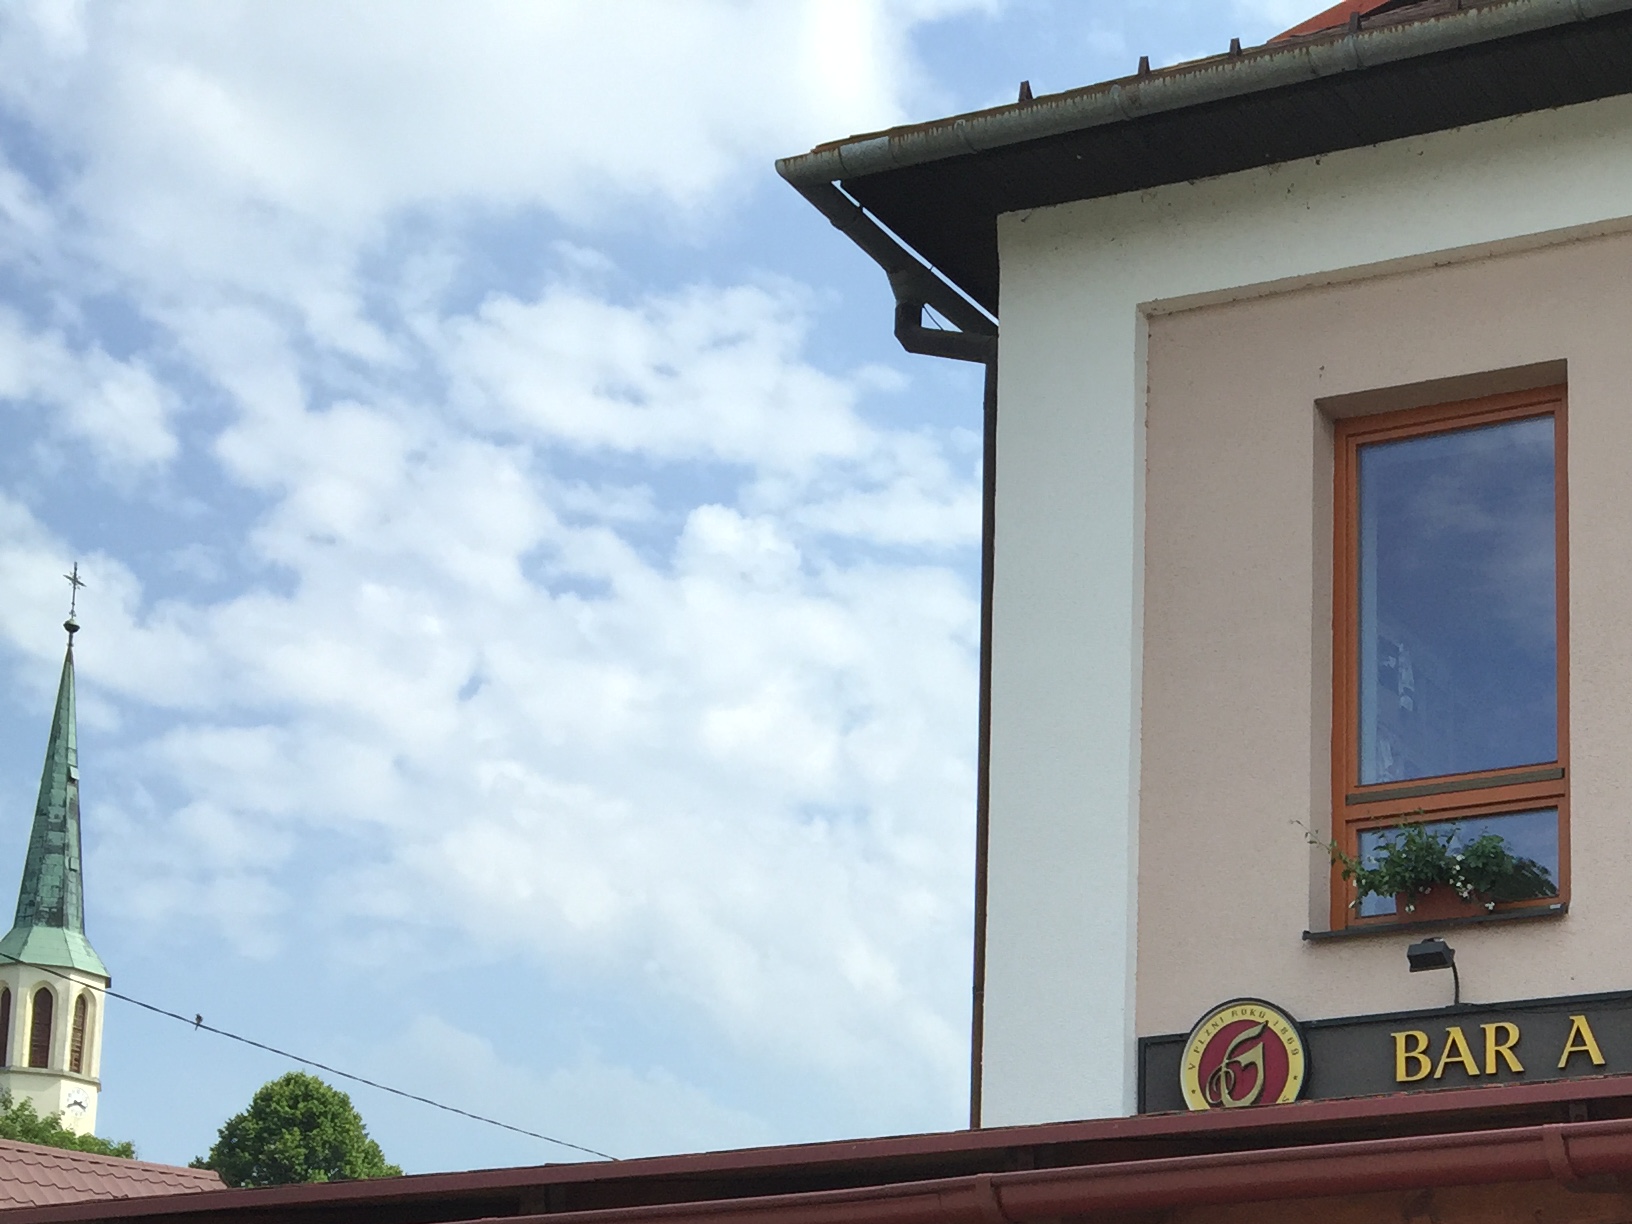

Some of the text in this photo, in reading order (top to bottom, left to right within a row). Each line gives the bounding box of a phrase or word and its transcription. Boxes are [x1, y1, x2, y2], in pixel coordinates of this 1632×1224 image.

[1231, 1008, 1267, 1020] ROKU
[1272, 1019, 1300, 1056] 1869
[1391, 1021, 1525, 1082] BAR
[1557, 1014, 1605, 1069] A
